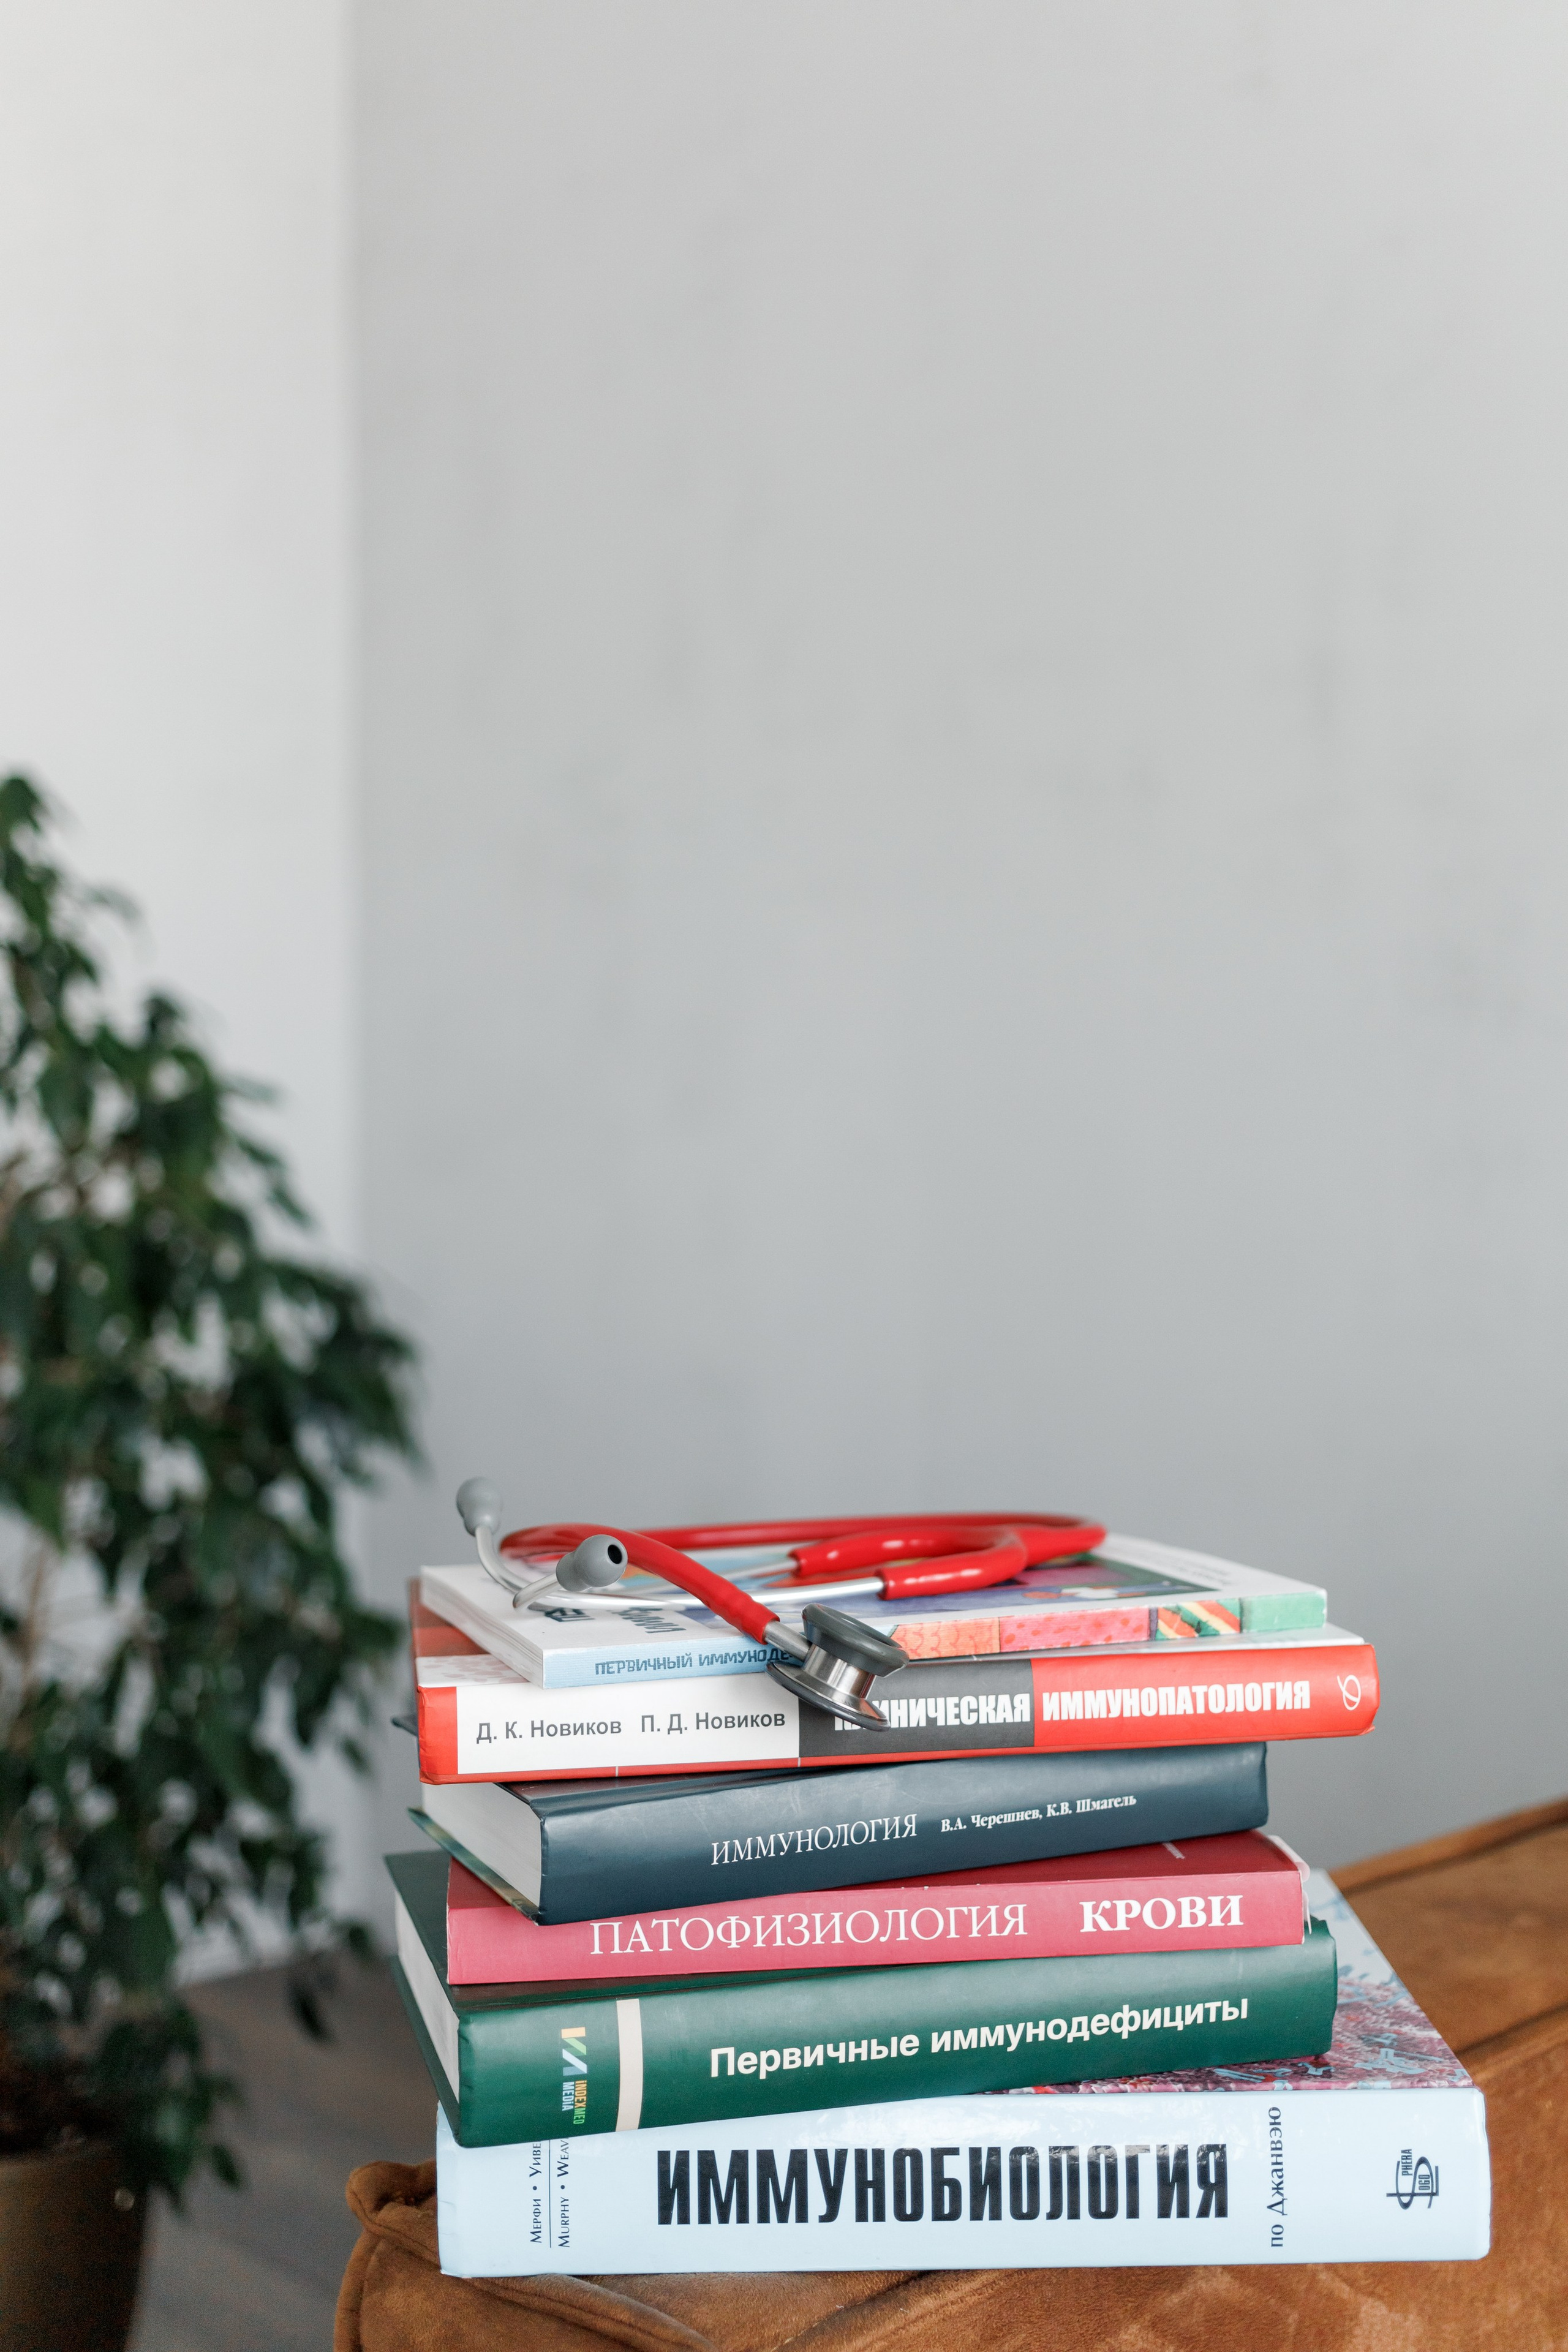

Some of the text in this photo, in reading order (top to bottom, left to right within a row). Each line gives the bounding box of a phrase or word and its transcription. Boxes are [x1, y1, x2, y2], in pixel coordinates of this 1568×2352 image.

[595, 1648, 793, 1675] ПЕРВИЧНЫЙ ИММУНОДЕ
[1042, 1681, 1311, 1721] ИММУНОПАТОЛОГИЯ
[477, 1712, 786, 1744] Д. К. Новиков П. Д. Новиков
[711, 1795, 1137, 1865] ИММУНОЛОГИЯ В.А. Черешнев, К.В. Шмагель
[590, 1895, 1244, 1954] ПАТОФИЗИОЛОГИЯ КРОВИ
[710, 1999, 1249, 2078] Первичные иммунодефициты
[529, 2140, 542, 2177] УИВЕ
[557, 2138, 569, 2177] WEAV
[1267, 2106, 1287, 2247] по Джанвэю
[657, 2143, 1228, 2225] ИММУНОБИОЛОГИЯ
